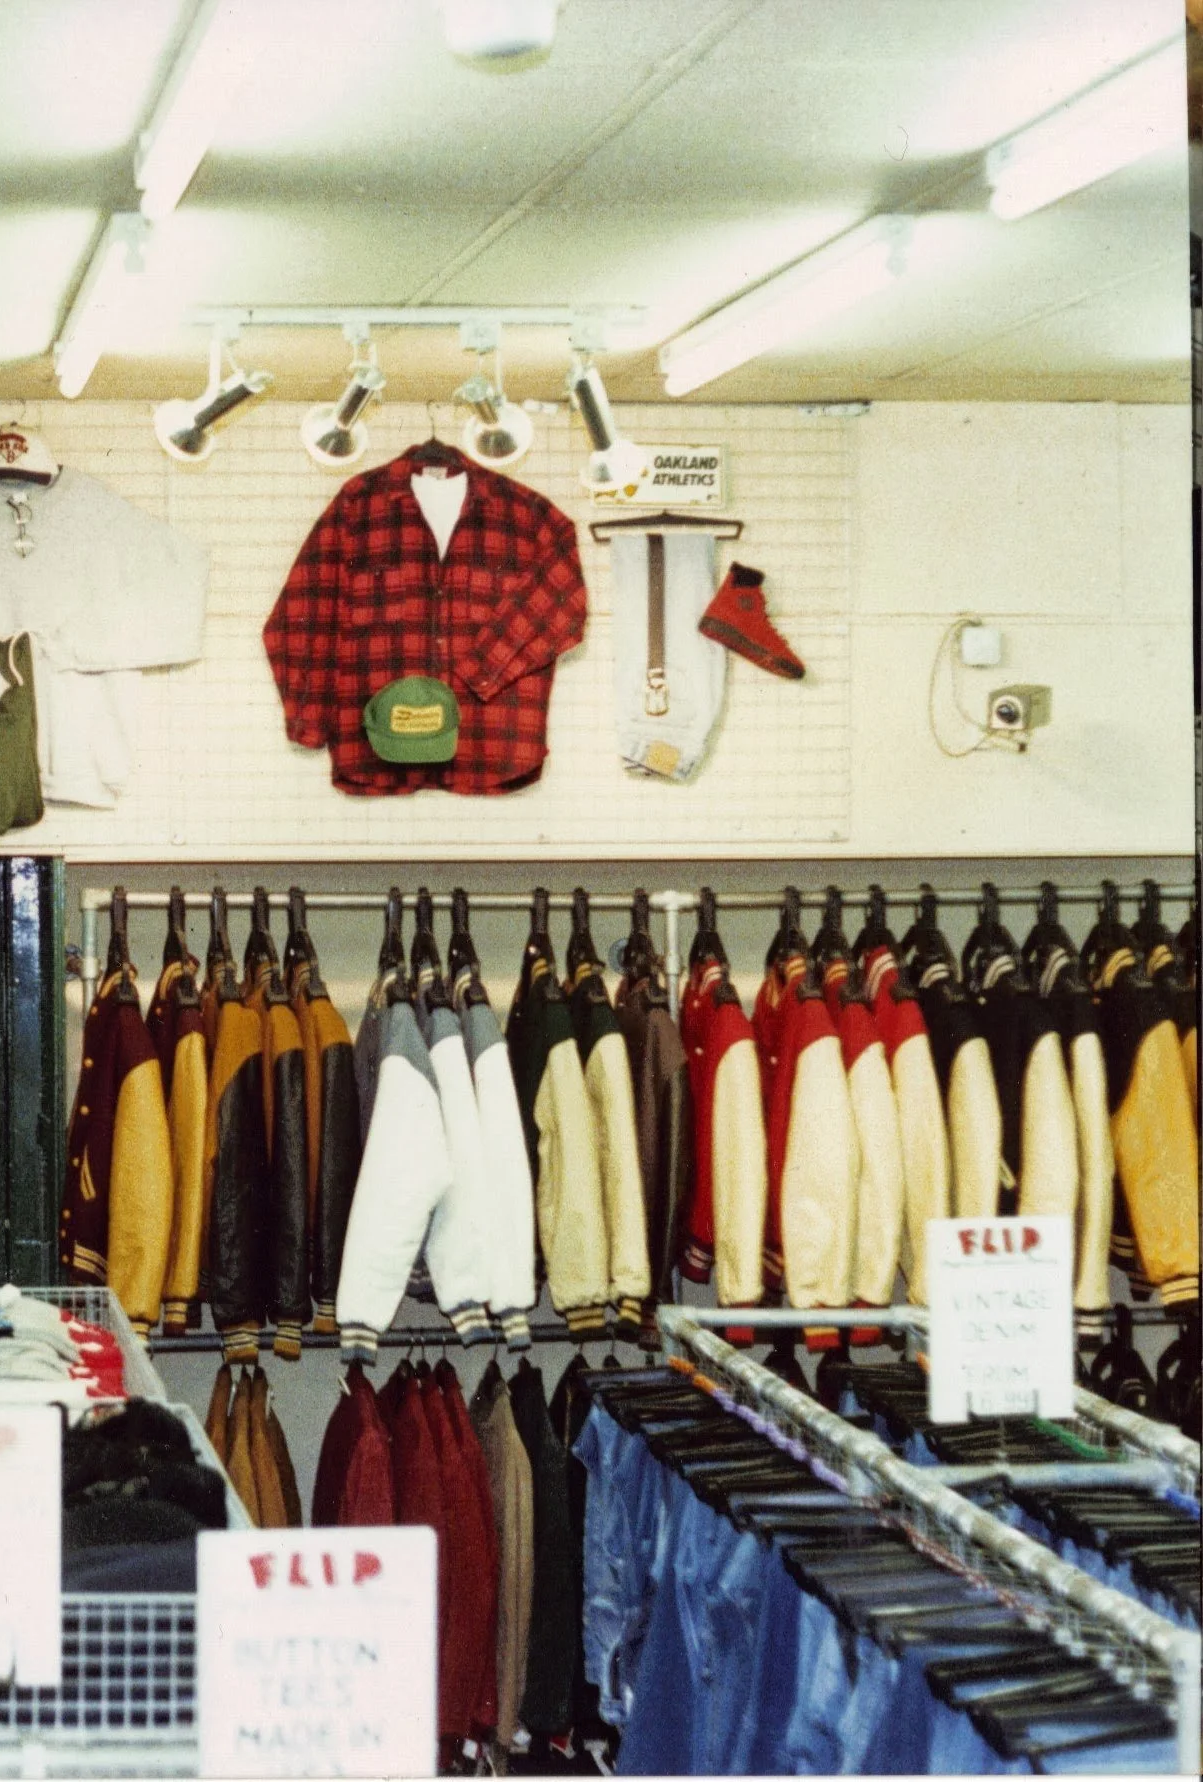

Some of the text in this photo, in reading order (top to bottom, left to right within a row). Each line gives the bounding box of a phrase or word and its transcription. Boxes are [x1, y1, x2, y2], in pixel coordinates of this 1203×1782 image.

[653, 455, 718, 470] OAKLAND
[652, 473, 715, 486] ATHLETICS
[957, 1226, 1042, 1256] FLIP
[246, 1548, 385, 1591] FLIP
